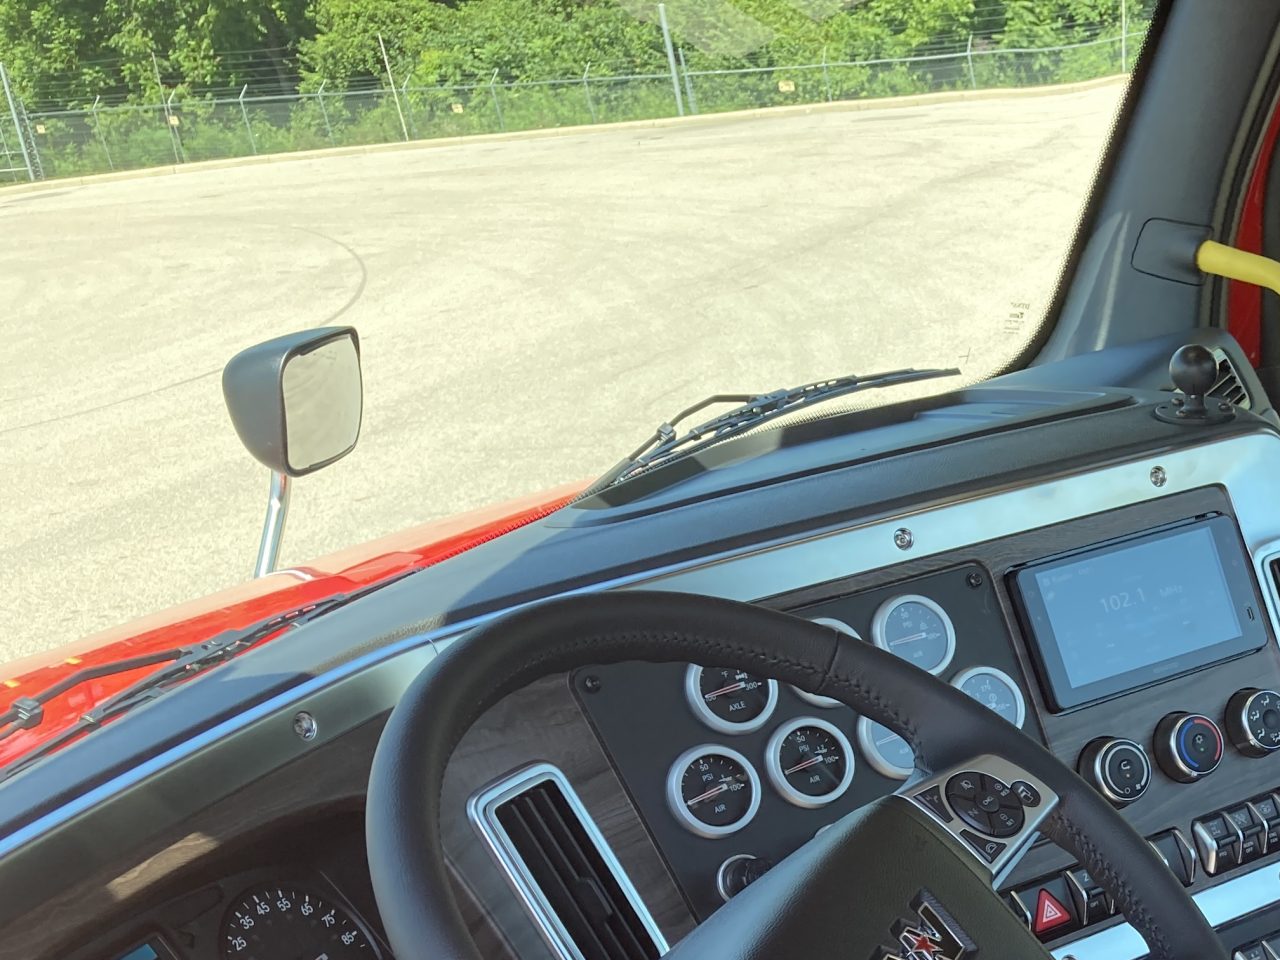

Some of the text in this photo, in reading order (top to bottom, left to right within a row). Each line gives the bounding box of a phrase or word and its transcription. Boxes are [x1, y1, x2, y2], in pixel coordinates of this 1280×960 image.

[1100, 587, 1146, 613] 102.1
[745, 681, 758, 691] 300
[729, 701, 746, 711] AXLE
[798, 745, 810, 753] PSI
[702, 773, 714, 782] PSI
[809, 775, 821, 783] AIR
[714, 804, 727, 813] AIR
[1082, 873, 1089, 882] 2
[256, 903, 270, 916] 45
[277, 898, 291, 912] 55
[300, 902, 314, 916] 65
[240, 915, 254, 930] 35
[321, 914, 336, 928] 75
[232, 936, 247, 951] 25
[341, 931, 355, 945] 85
